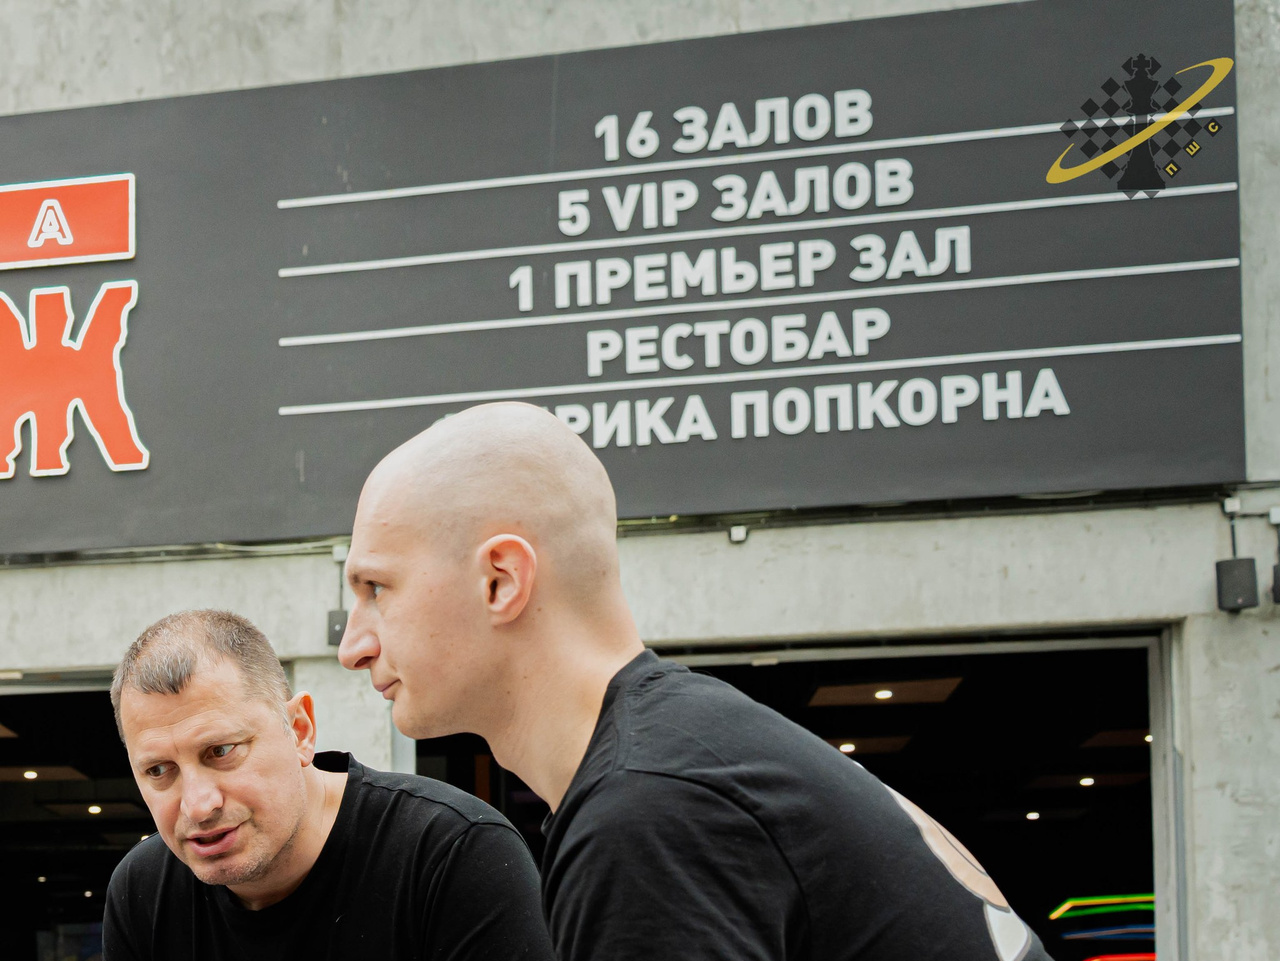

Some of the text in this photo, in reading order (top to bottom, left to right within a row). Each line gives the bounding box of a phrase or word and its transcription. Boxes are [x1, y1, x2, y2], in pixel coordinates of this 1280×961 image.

[595, 89, 873, 161] 16 ЗАЛОВ
[557, 158, 913, 236] 5 VIP ЗАЛОВ
[510, 226, 971, 311] 1 ПРЕМЬЕР ЗАЛ
[587, 308, 891, 377] РЕСТОБАР
[542, 369, 1071, 448] РИКА ПОПКОРНА
